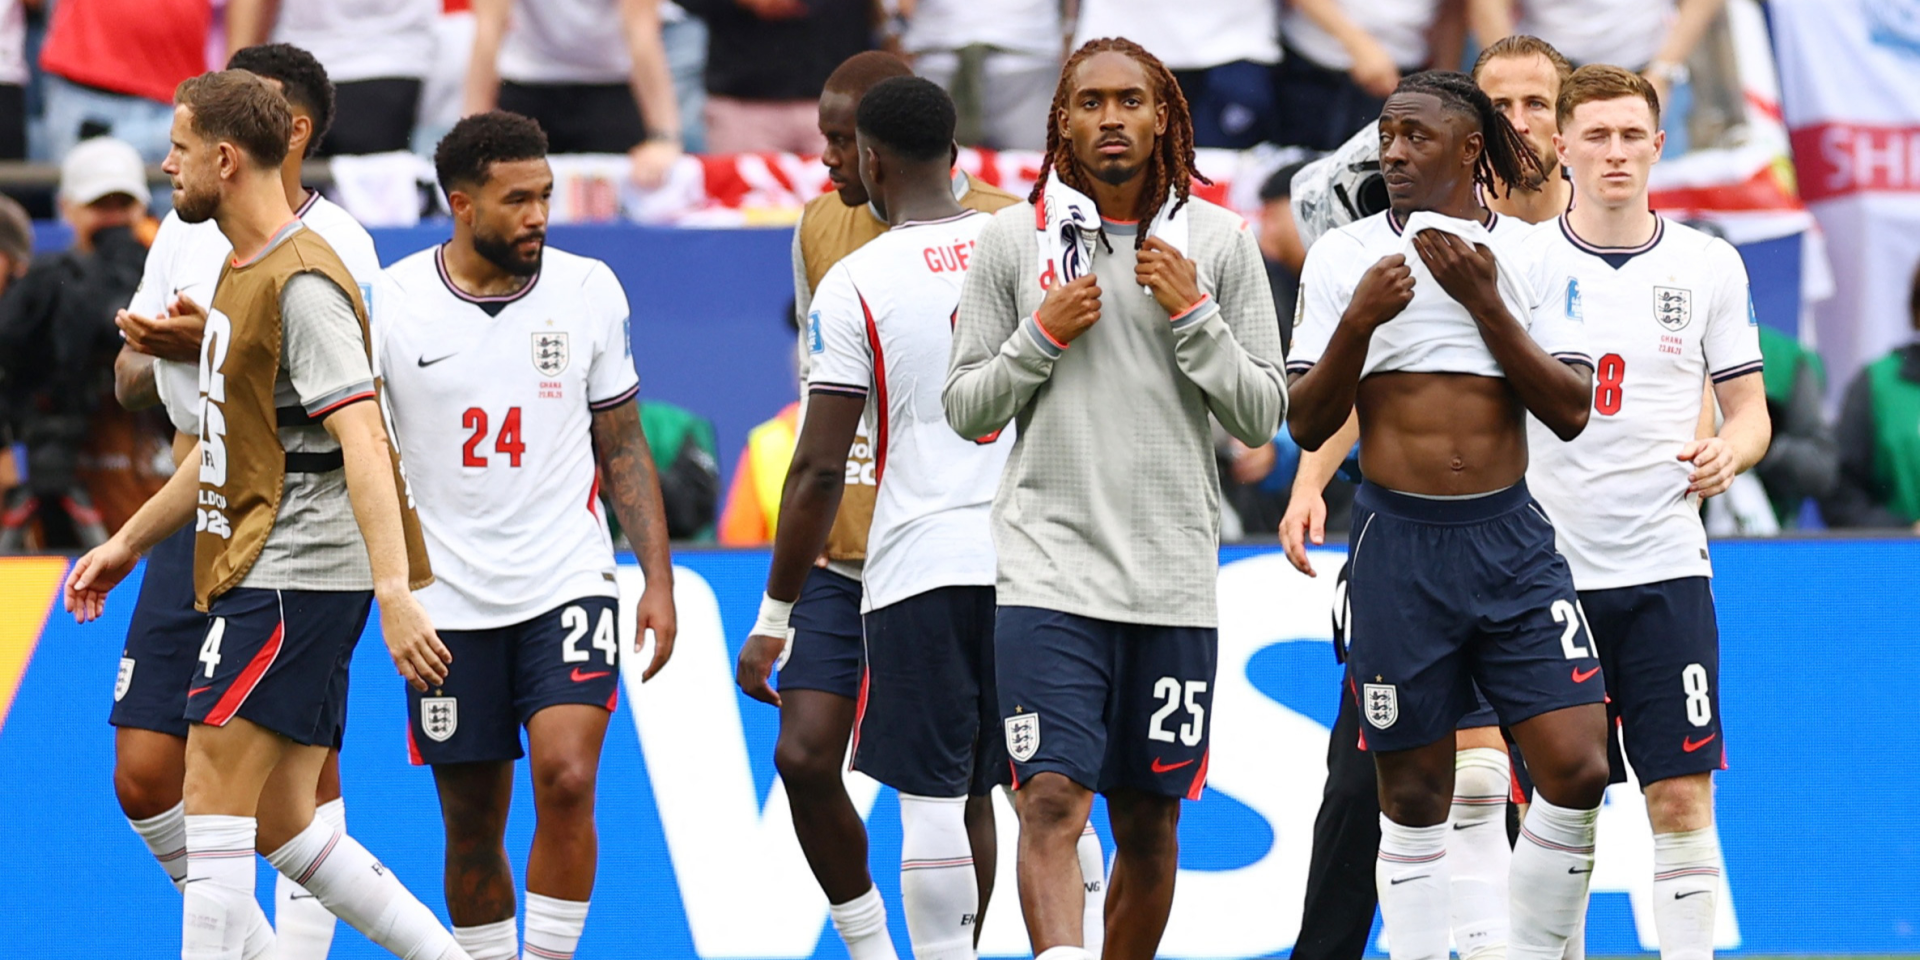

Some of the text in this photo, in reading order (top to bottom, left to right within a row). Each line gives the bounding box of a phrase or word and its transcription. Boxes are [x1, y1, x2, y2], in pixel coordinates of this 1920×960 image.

[923, 239, 976, 273] GUÉ
[1660, 335, 1682, 344] GHANA
[1594, 353, 1626, 416] 8
[463, 406, 526, 468] 24
[845, 460, 877, 486] 20
[561, 605, 617, 666] 24
[1148, 676, 1208, 747] 25
[1682, 662, 1712, 727] 8
[615, 551, 1742, 957] VS
[1084, 880, 1101, 892] NG
[961, 913, 977, 926] EN
